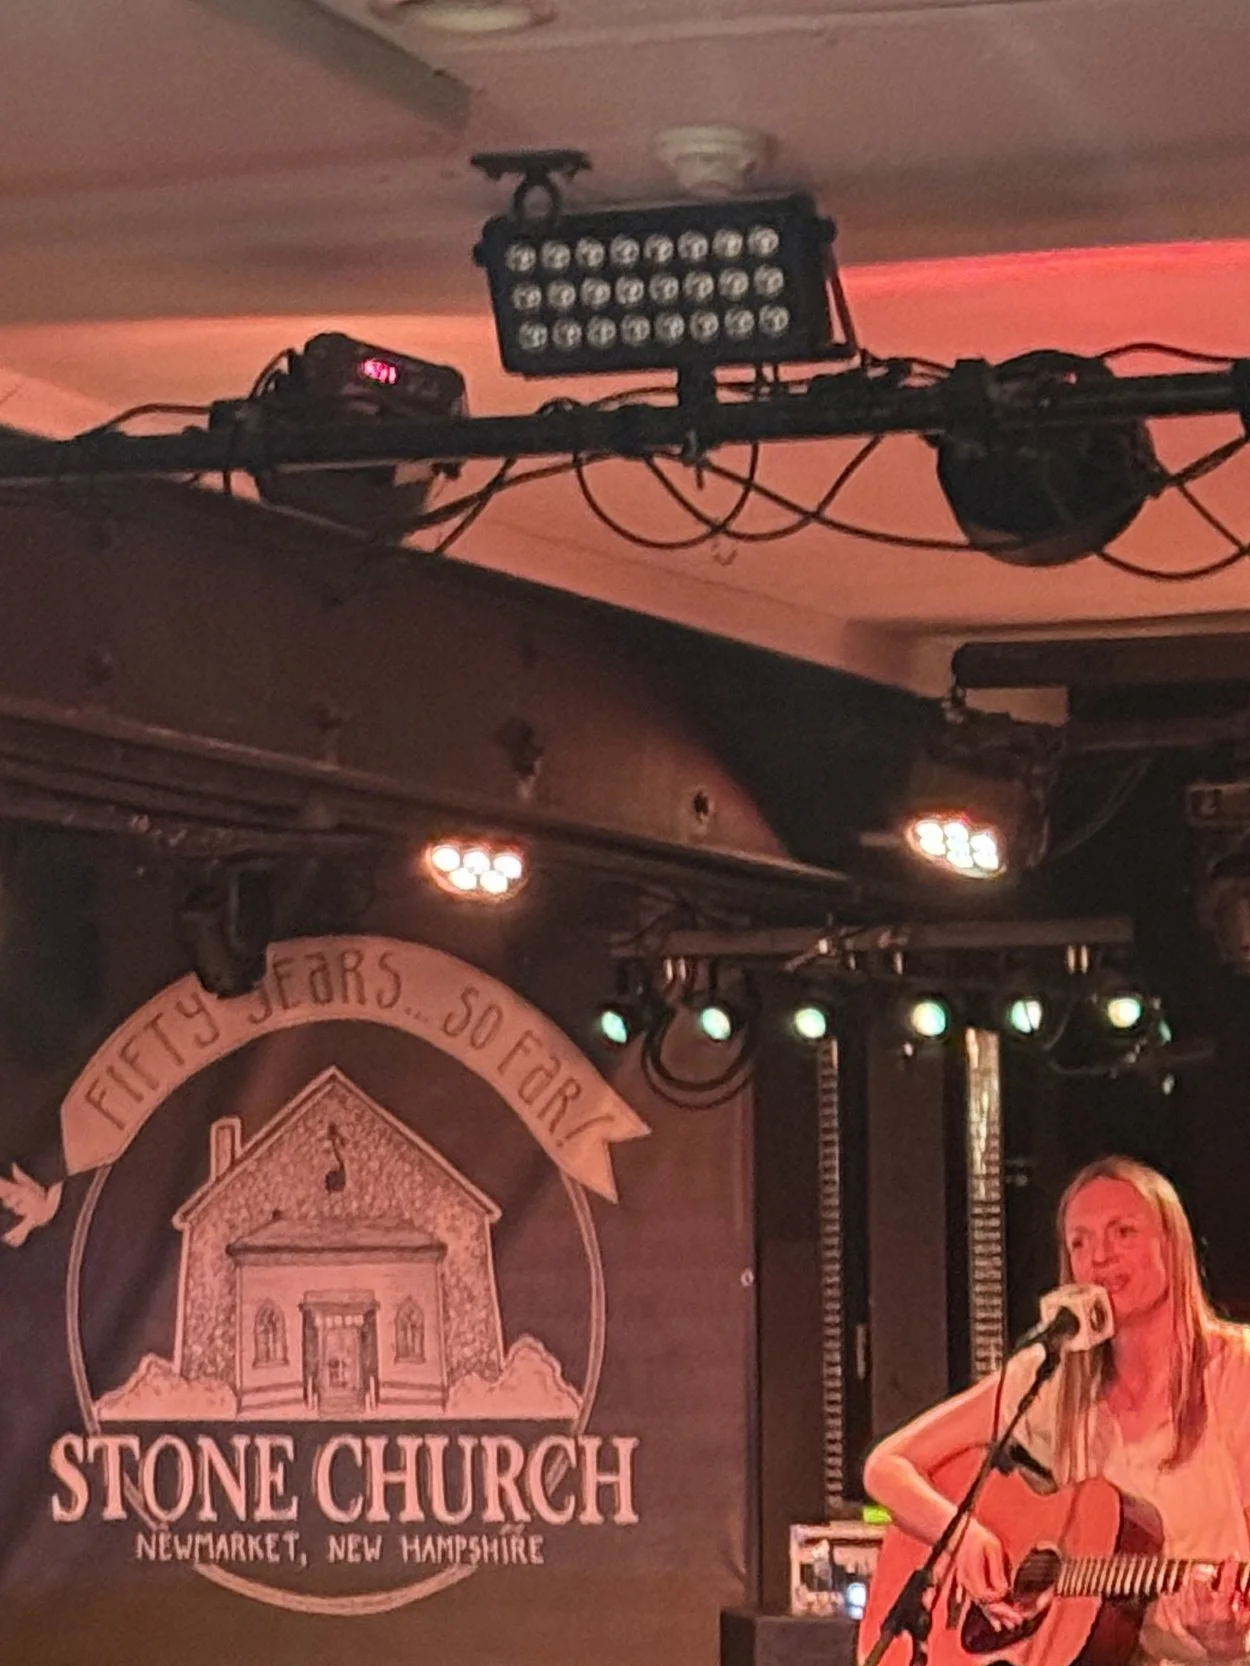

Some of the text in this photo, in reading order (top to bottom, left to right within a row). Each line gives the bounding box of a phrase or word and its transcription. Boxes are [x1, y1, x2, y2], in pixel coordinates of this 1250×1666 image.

[443, 986, 503, 1050] SO
[50, 1433, 640, 1525] STONE CHURCH
[136, 1530, 545, 1567] NEWMARKET, NEW HAMPSHIRE
